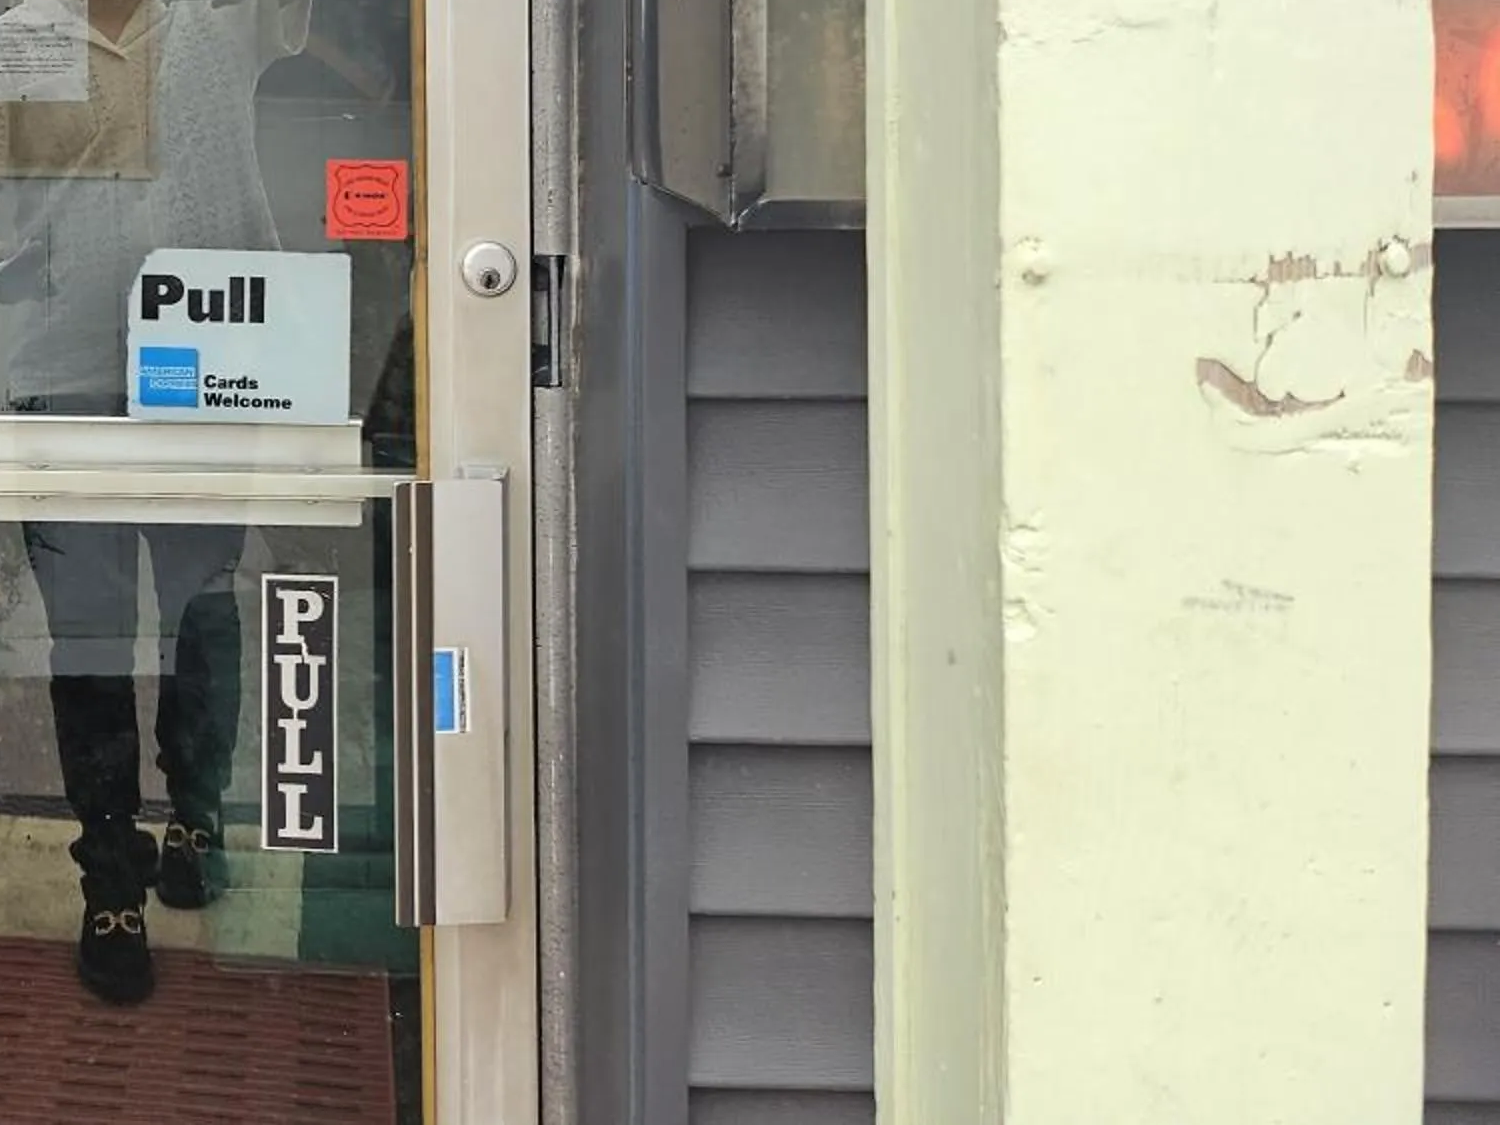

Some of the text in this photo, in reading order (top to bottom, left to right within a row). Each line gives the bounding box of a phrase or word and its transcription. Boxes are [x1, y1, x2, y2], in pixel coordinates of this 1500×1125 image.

[140, 274, 266, 324] Pull
[204, 374, 259, 390] Cards
[204, 393, 293, 410] Welcome
[273, 586, 327, 840] PULL
